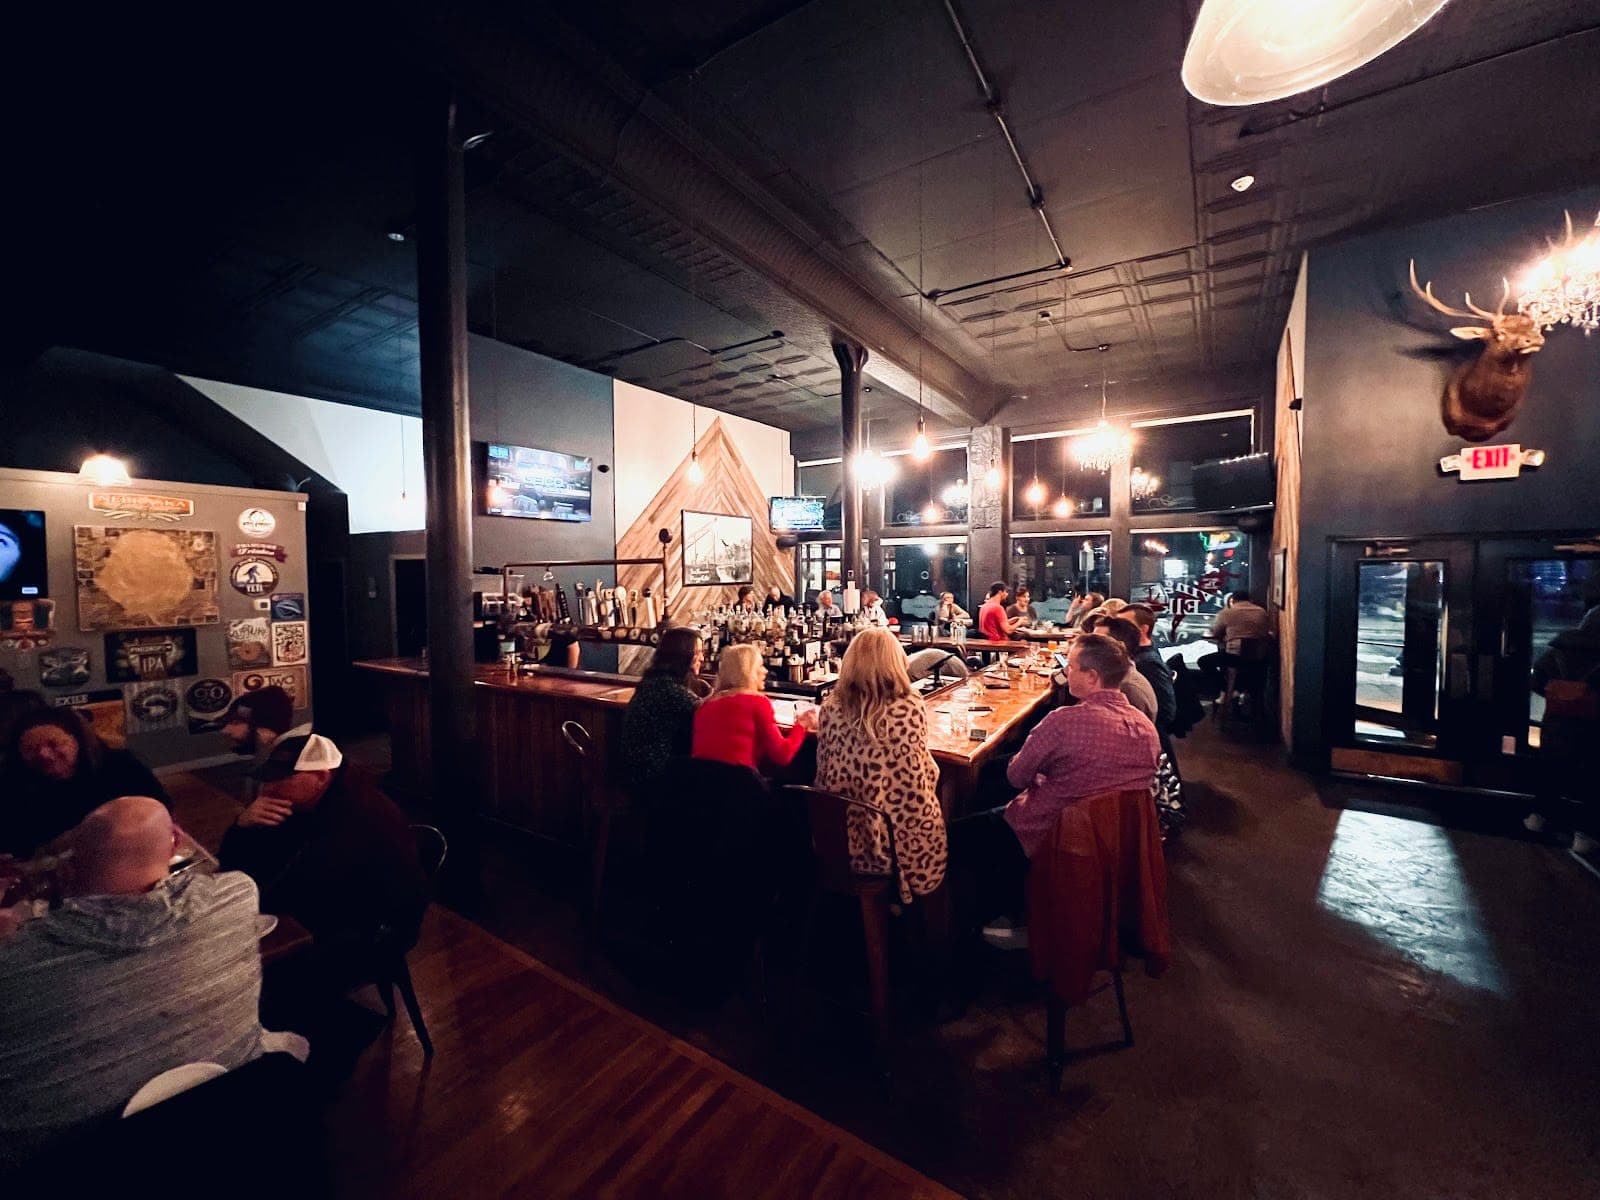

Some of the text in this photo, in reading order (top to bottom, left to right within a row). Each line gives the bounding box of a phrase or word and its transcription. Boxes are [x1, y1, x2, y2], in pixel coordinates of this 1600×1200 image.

[1472, 447, 1509, 470] EXIT
[246, 584, 264, 593] YETI
[143, 657, 165, 673] IPA
